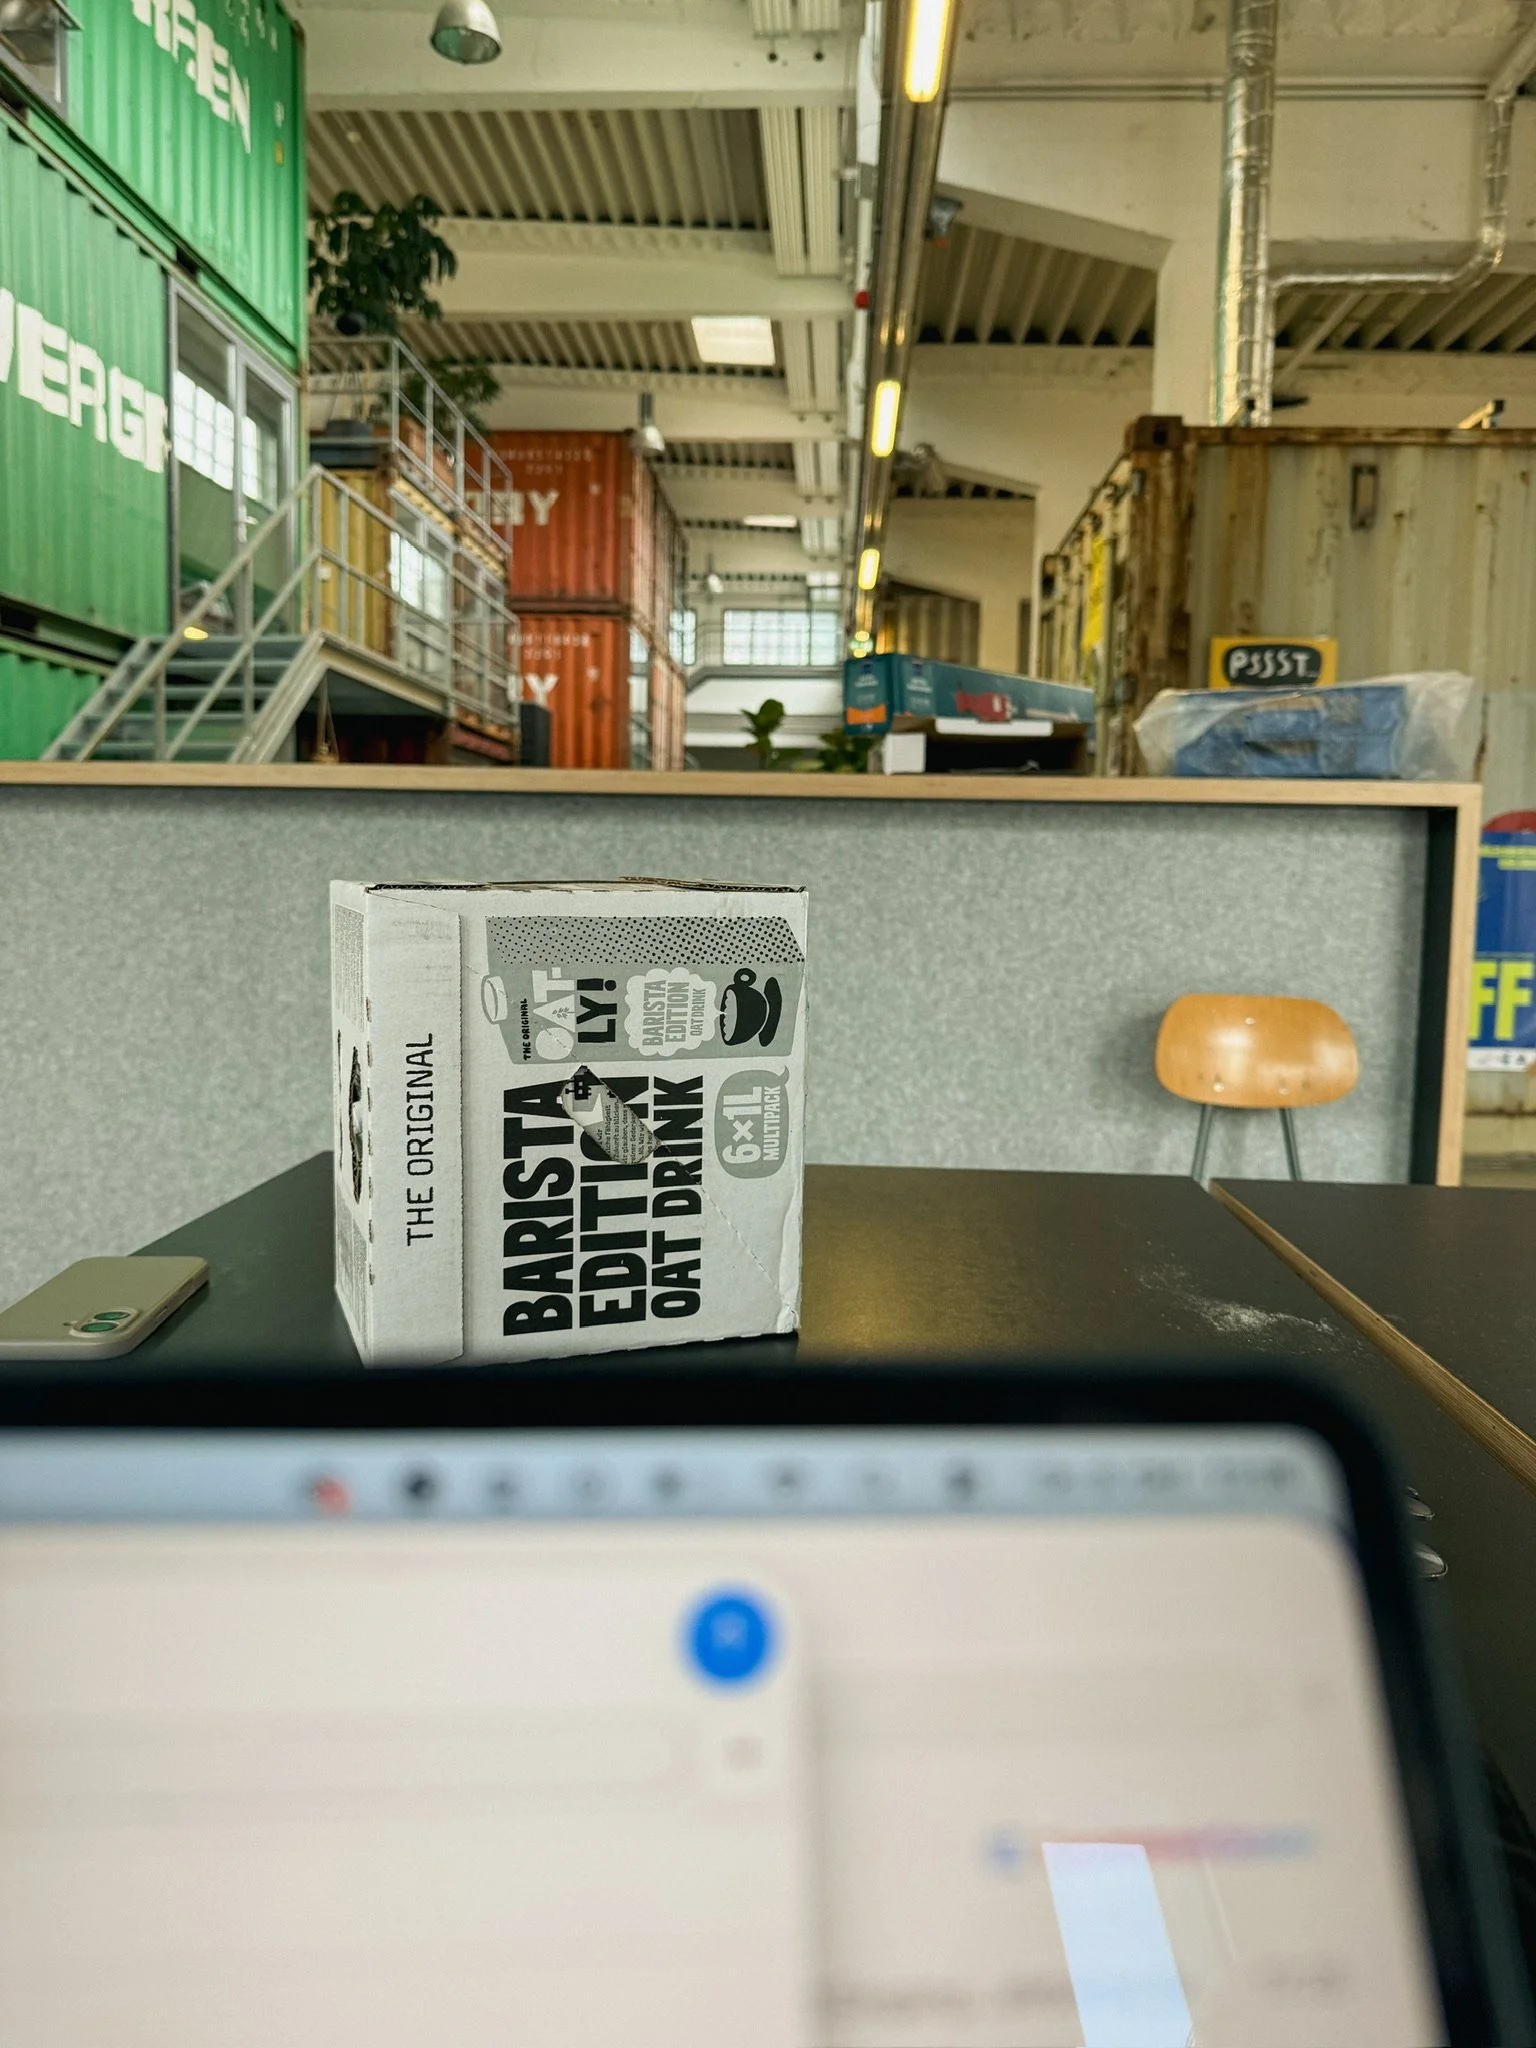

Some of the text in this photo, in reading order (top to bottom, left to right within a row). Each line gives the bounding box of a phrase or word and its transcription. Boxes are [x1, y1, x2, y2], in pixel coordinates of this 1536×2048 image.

[519, 998, 531, 1061] THE ORIGINAL
[576, 978, 618, 1043] LY!
[642, 980, 667, 1046] BARISTA
[665, 982, 690, 1042] EDITION
[690, 988, 707, 1037] OAT DRINK
[406, 1033, 434, 1247] THE ORIGINAL
[762, 1085, 781, 1161] MULTIPACK
[503, 1079, 575, 1337] BARISTA
[651, 1075, 704, 1319] OAT DRINK
